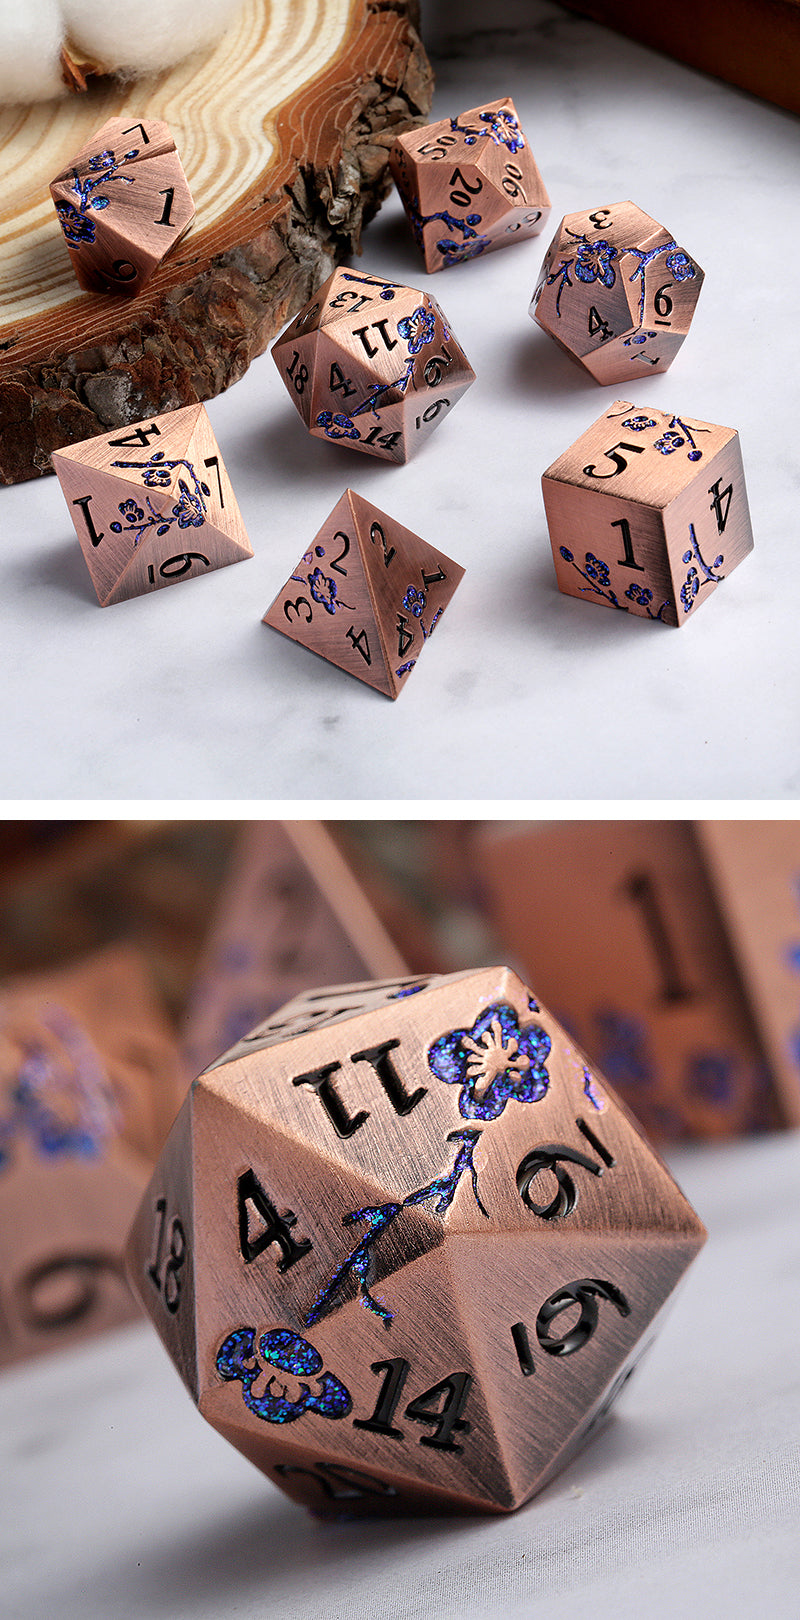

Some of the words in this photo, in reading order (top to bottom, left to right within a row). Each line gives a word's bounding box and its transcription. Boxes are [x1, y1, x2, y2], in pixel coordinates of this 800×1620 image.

[122, 123, 149, 144] 7
[418, 135, 457, 161] 50
[154, 187, 175, 227] 1
[448, 167, 483, 207] 20
[588, 210, 613, 230] 3
[329, 291, 373, 313] 13
[352, 318, 398, 359] 11
[588, 306, 613, 340] 4
[286, 351, 308, 395] 18
[630, 350, 660, 365] 1
[329, 362, 357, 398] 4
[108, 423, 161, 447] 4
[359, 426, 403, 450] 14
[582, 441, 646, 479] 5
[203, 456, 225, 509] 7
[72, 495, 104, 547] 1
[707, 477, 733, 536] 4
[329, 531, 350, 577] 2
[369, 521, 397, 568] 2
[611, 518, 645, 572] 1
[420, 563, 448, 592] 1
[283, 596, 313, 624] 3
[345, 625, 371, 666] 4
[396, 611, 414, 658] 4
[622, 868, 697, 1008] 1
[292, 1038, 428, 1139] 11
[237, 1167, 314, 1274] 4
[148, 1198, 187, 1315] 18
[353, 1357, 478, 1455] 14
